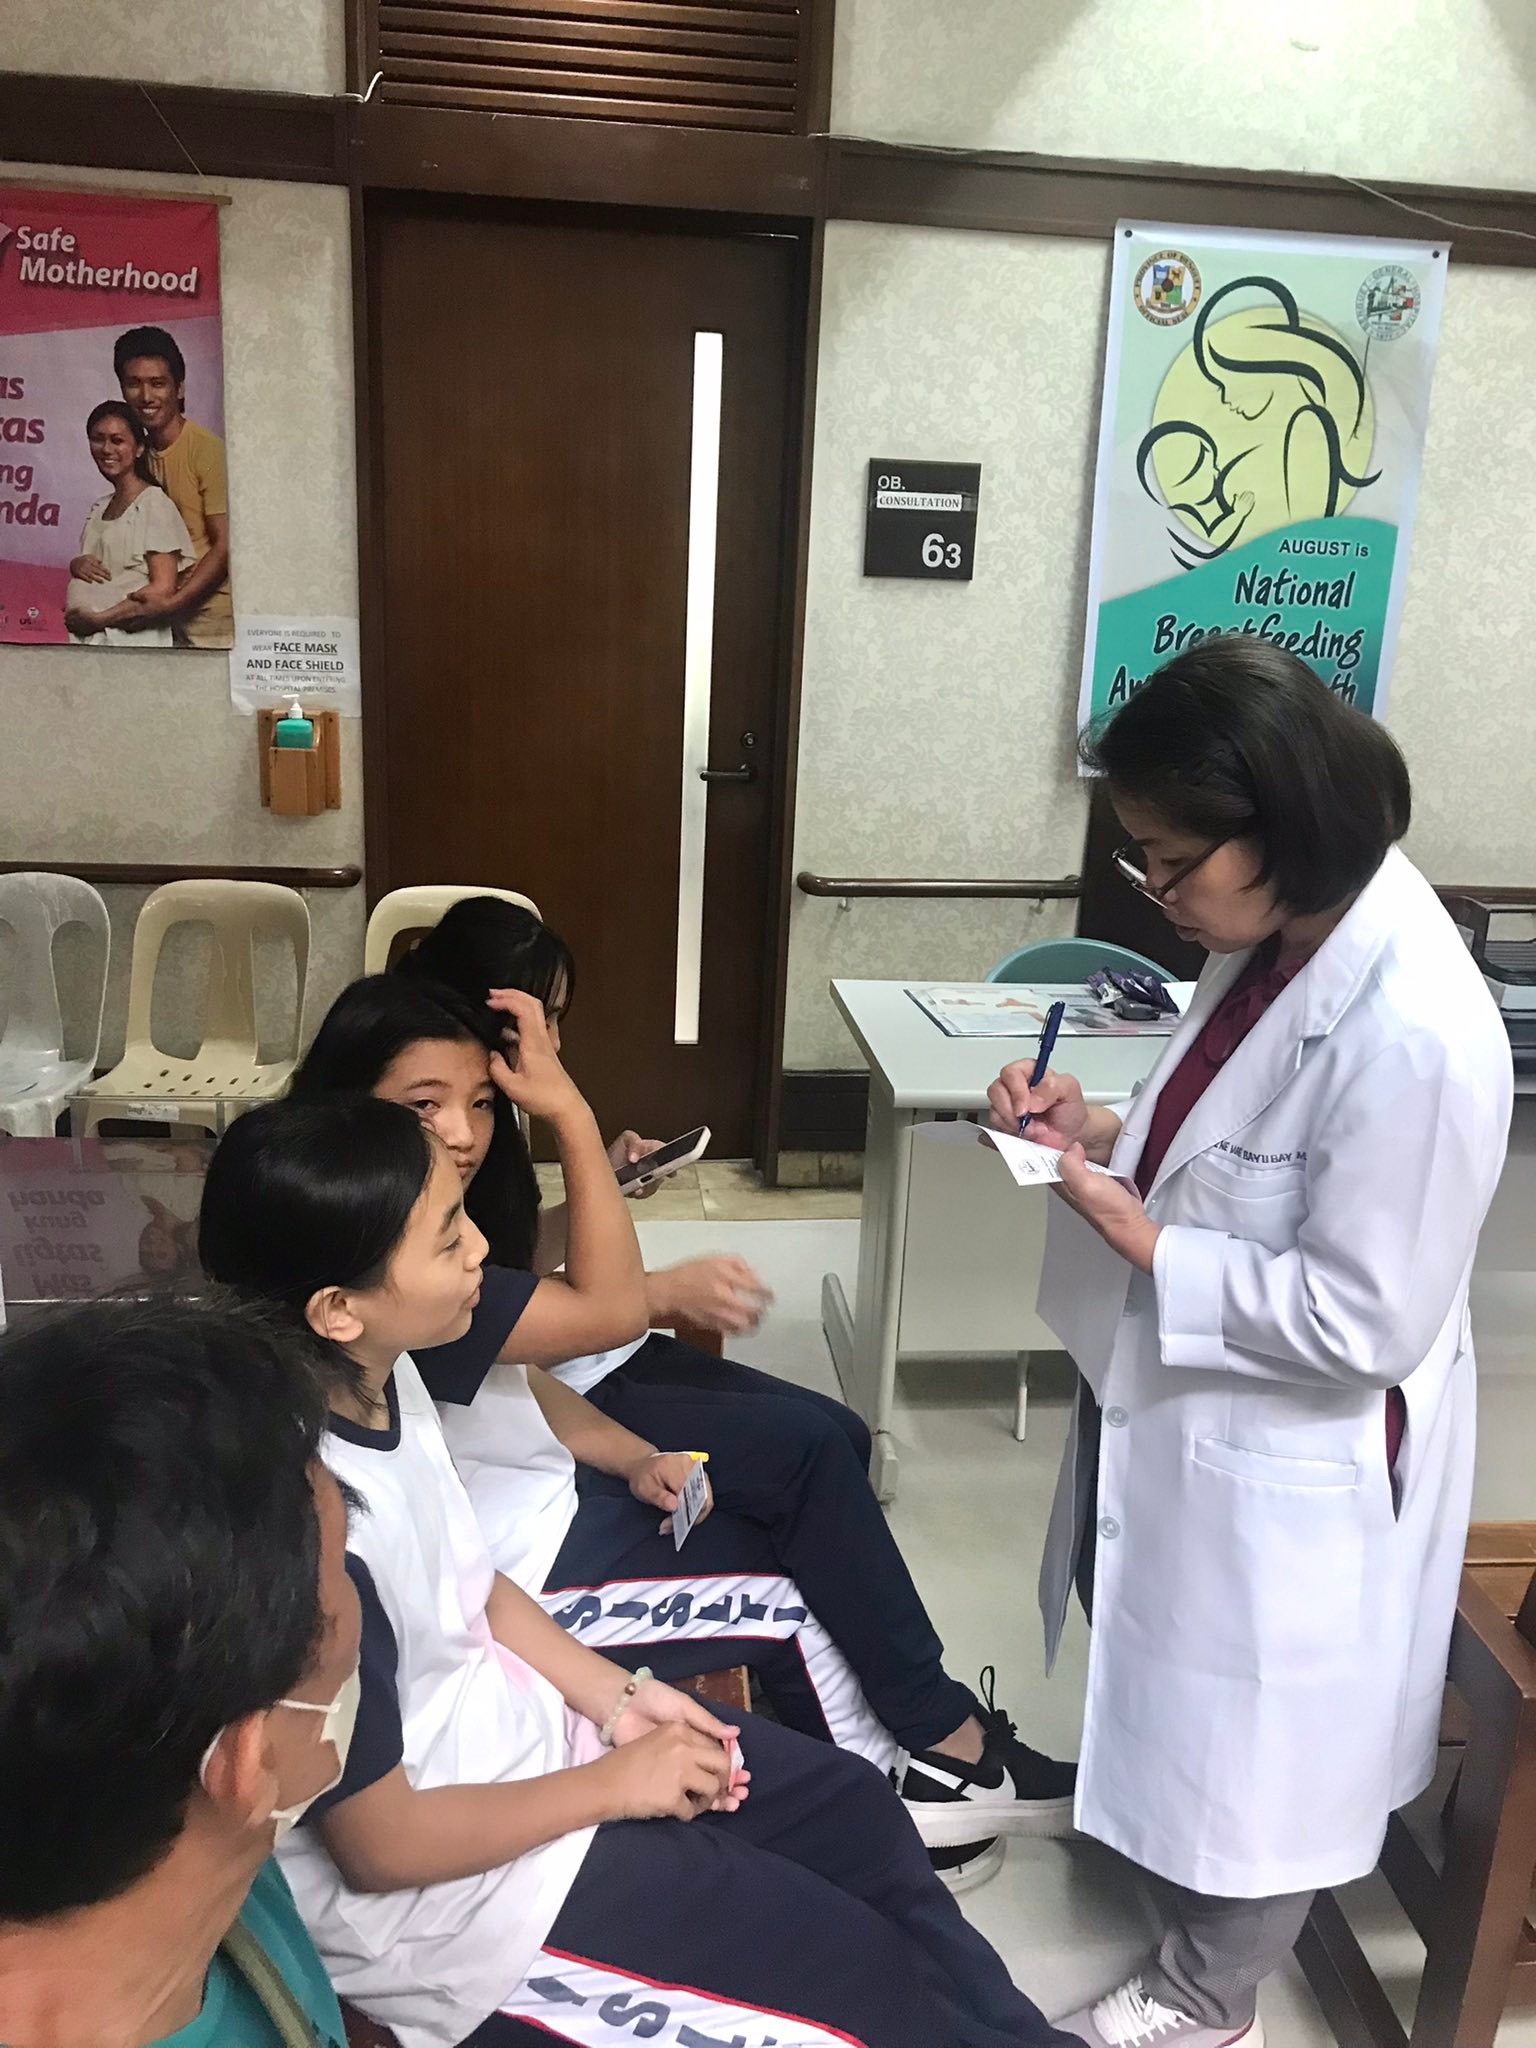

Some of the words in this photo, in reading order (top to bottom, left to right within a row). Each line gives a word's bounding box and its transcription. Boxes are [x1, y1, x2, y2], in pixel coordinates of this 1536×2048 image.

[16, 225, 76, 252] Safe
[19, 256, 198, 293] Motherhood
[877, 475, 906, 490] OB.
[879, 495, 960, 508] CONSULTATION
[921, 533, 962, 569] 63
[1279, 539, 1351, 557] AUGUST
[1355, 543, 1369, 557] is
[1234, 564, 1356, 608] National
[247, 629, 282, 637] EVERYONE
[291, 630, 326, 638] REQUIRED
[273, 642, 301, 652] FACE
[304, 643, 338, 653] MASK
[246, 659, 272, 669] AND
[275, 660, 302, 669] FACE
[305, 660, 344, 671] SHIELD
